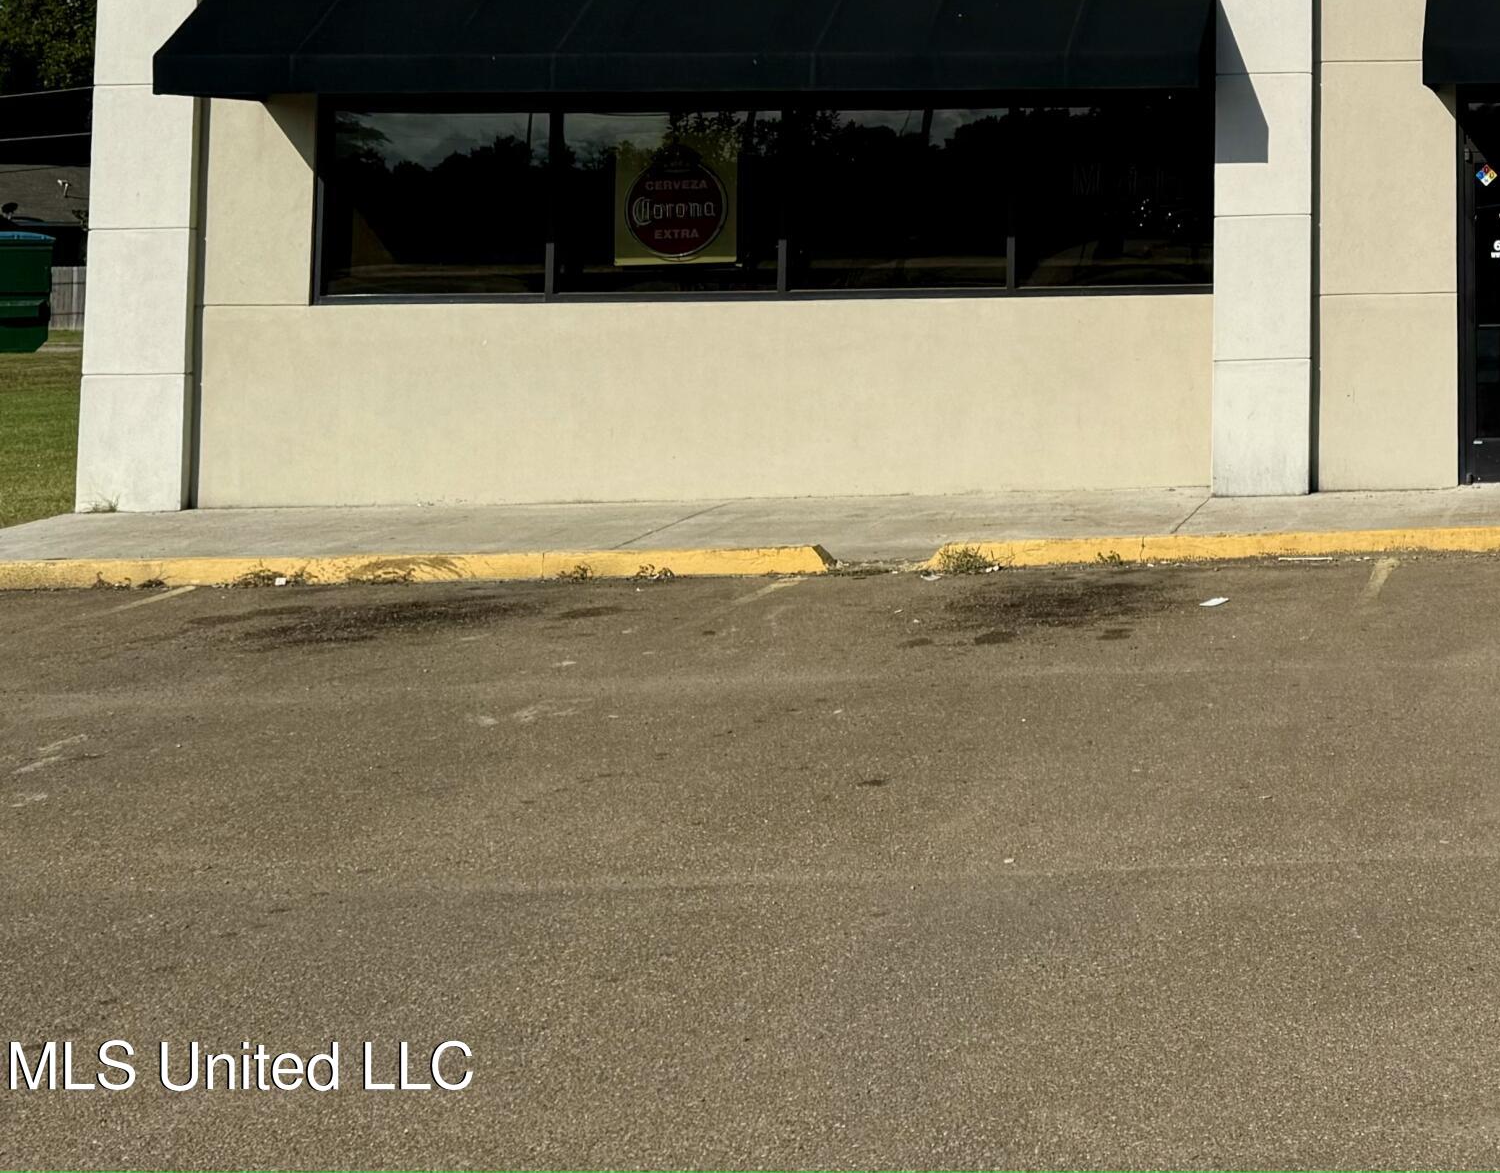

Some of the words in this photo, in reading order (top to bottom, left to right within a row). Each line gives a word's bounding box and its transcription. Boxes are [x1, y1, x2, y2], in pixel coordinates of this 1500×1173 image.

[645, 179, 708, 191] CERVEZA
[632, 196, 716, 227] Corona
[654, 228, 700, 240] EXTRA
